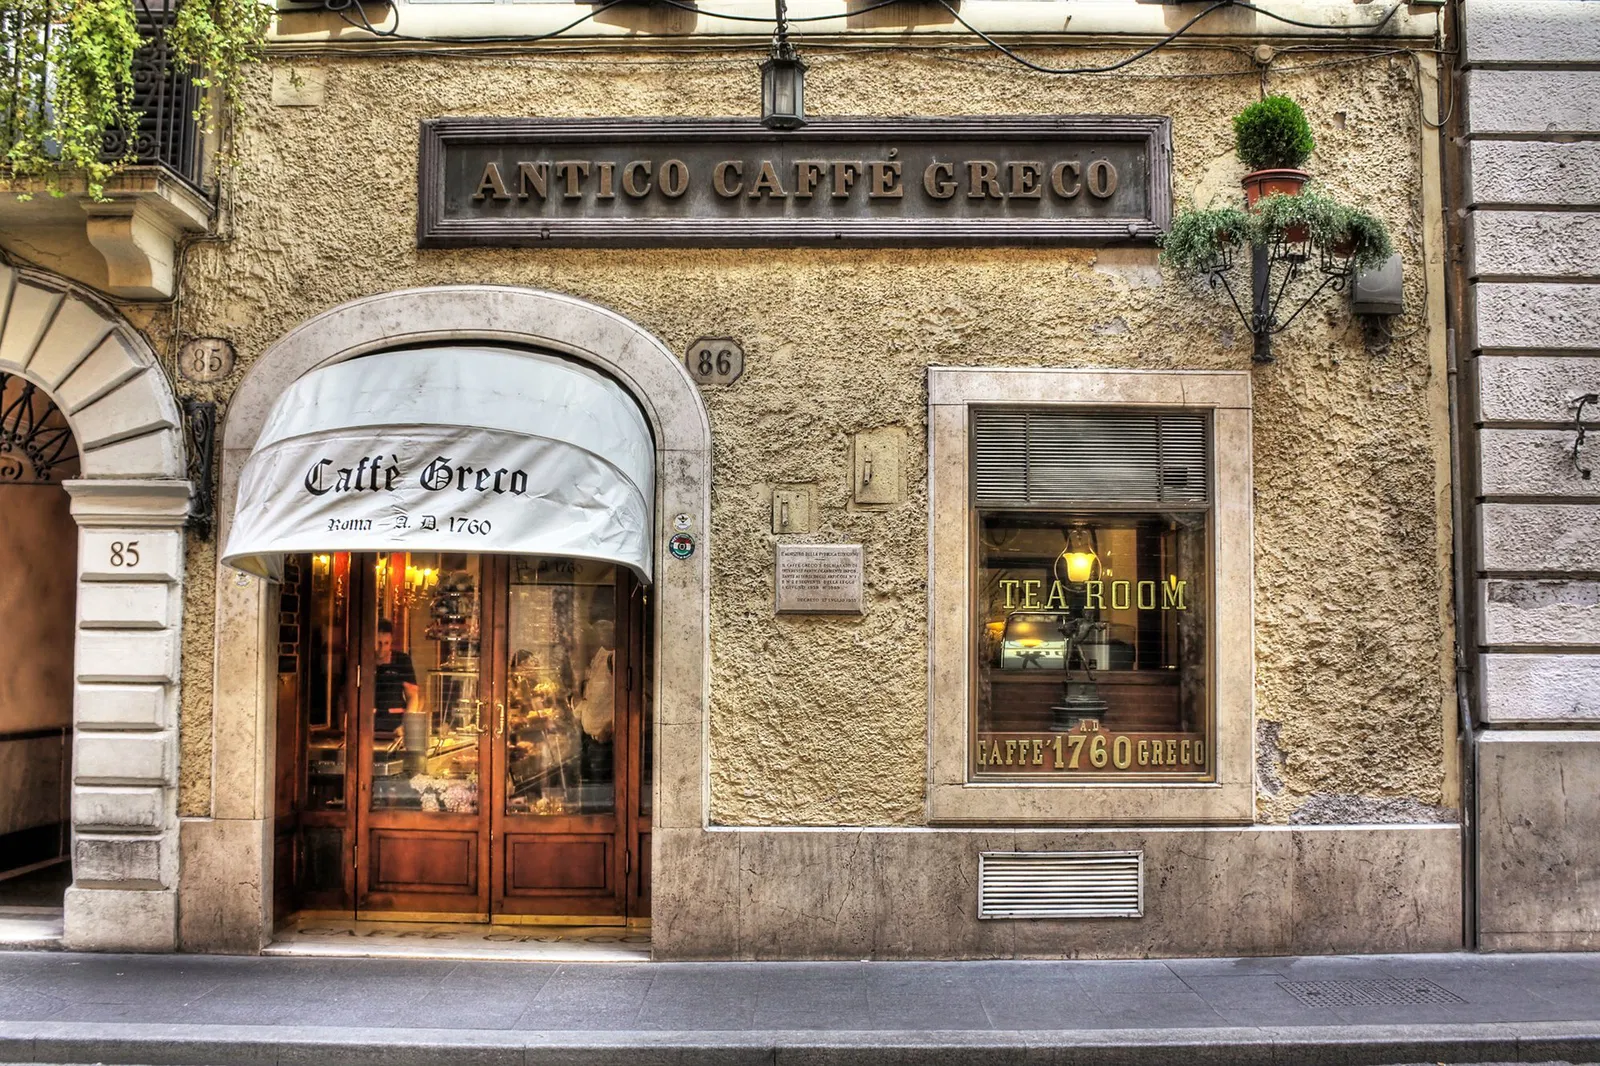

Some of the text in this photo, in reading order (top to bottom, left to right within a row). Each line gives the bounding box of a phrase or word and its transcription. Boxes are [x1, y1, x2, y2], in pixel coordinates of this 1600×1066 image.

[472, 158, 690, 200] ANTICO
[922, 158, 1118, 199] GRECO
[193, 348, 222, 373] 85
[697, 349, 732, 376] 86
[304, 453, 529, 496] Caffè Greco
[327, 517, 373, 532] Roma
[449, 516, 492, 535] 1760
[110, 540, 140, 567] 85
[999, 579, 1187, 610] TEA ROOM
[1053, 734, 1132, 770] 1760
[1137, 739, 1205, 766] GRECO
